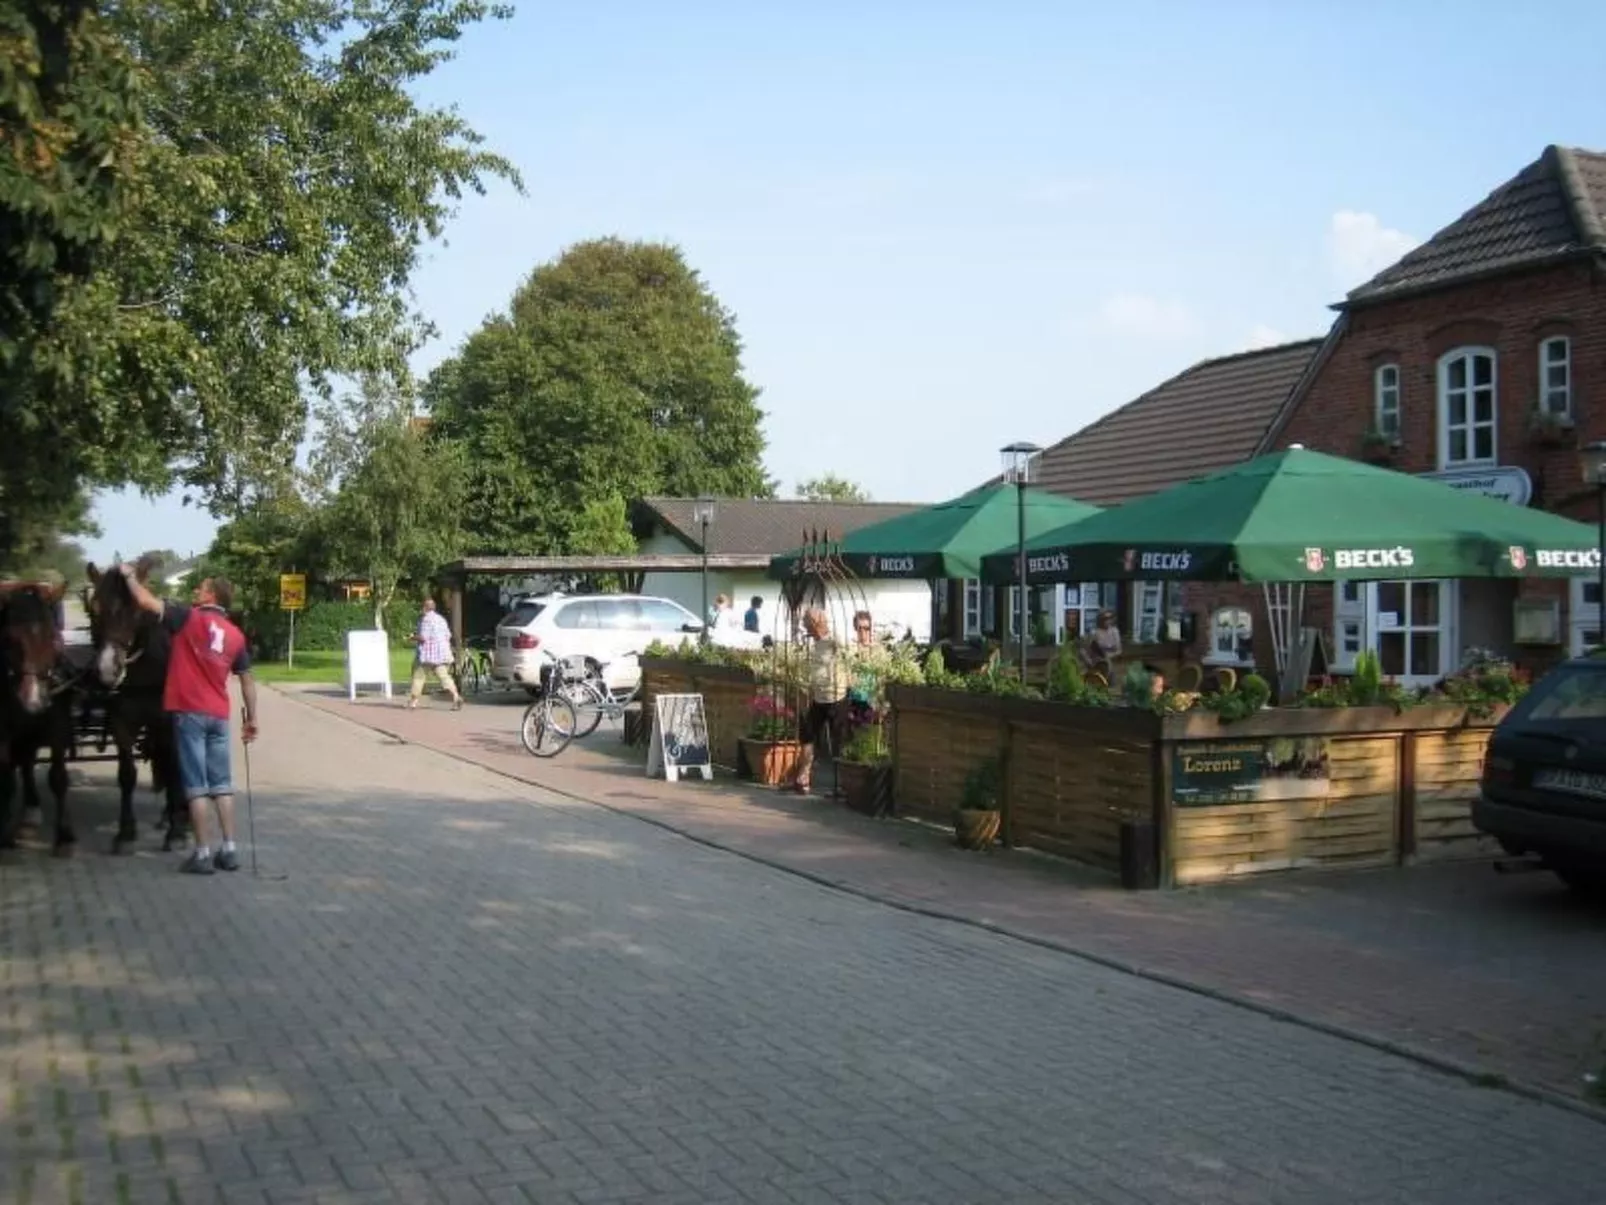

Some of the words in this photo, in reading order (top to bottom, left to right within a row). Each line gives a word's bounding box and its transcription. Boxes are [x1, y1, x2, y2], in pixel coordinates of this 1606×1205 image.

[1029, 553, 1069, 572] BECK'S
[1141, 550, 1191, 569] BECK'S
[1335, 546, 1414, 568] BECK'S
[1184, 757, 1241, 773] Lorenz
